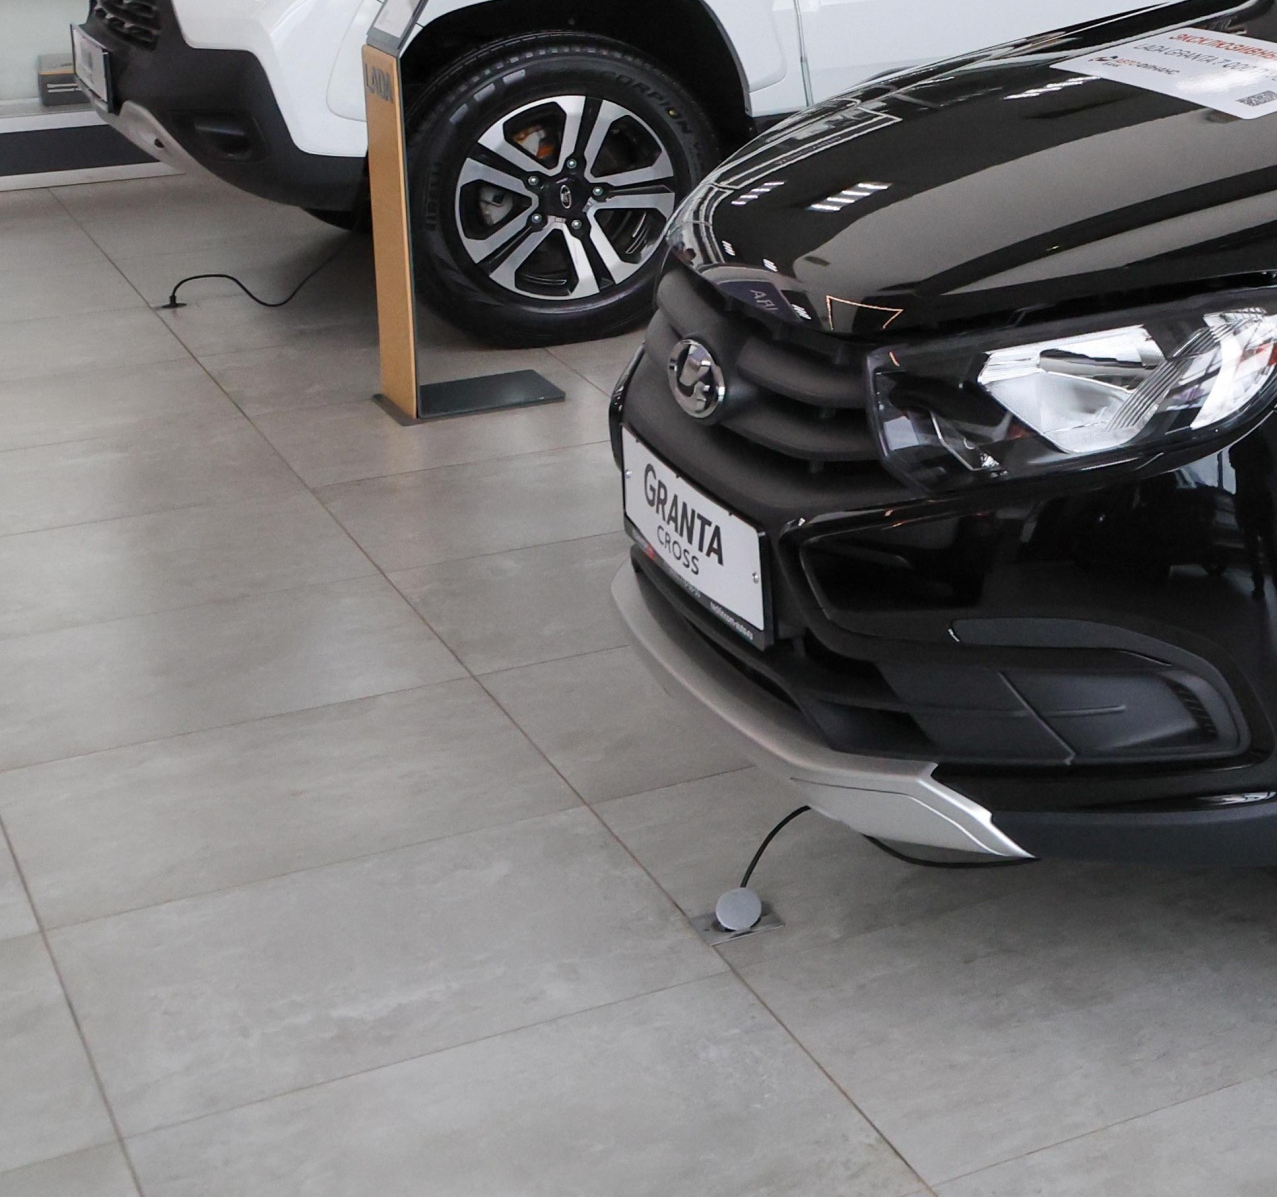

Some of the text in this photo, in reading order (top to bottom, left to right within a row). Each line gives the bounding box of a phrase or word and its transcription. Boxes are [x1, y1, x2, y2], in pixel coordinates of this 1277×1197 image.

[1164, 49, 1218, 62] GRANTA
[364, 63, 393, 104] LADA
[644, 463, 724, 566] GRANTA
[656, 525, 700, 576] CROSS
